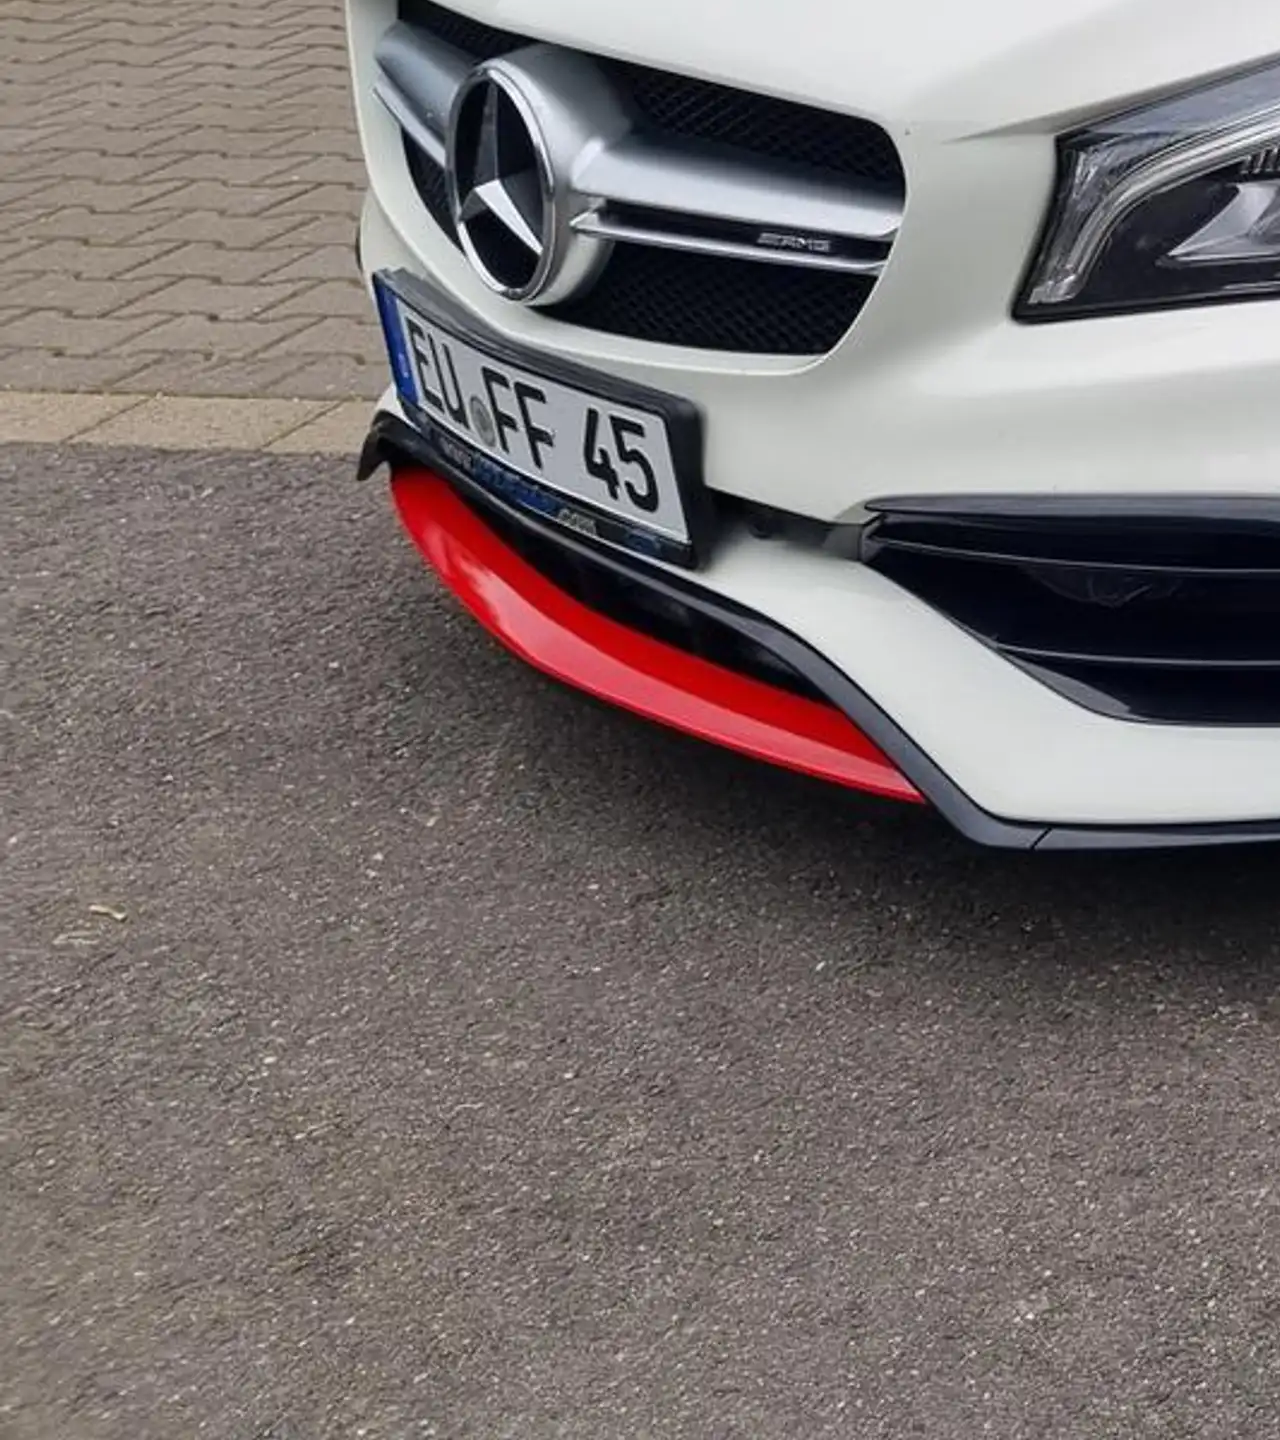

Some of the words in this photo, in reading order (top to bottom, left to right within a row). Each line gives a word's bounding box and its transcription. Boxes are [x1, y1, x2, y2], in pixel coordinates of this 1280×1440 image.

[404, 315, 470, 431] EU
[481, 366, 555, 470] FF
[583, 407, 659, 513] 45
